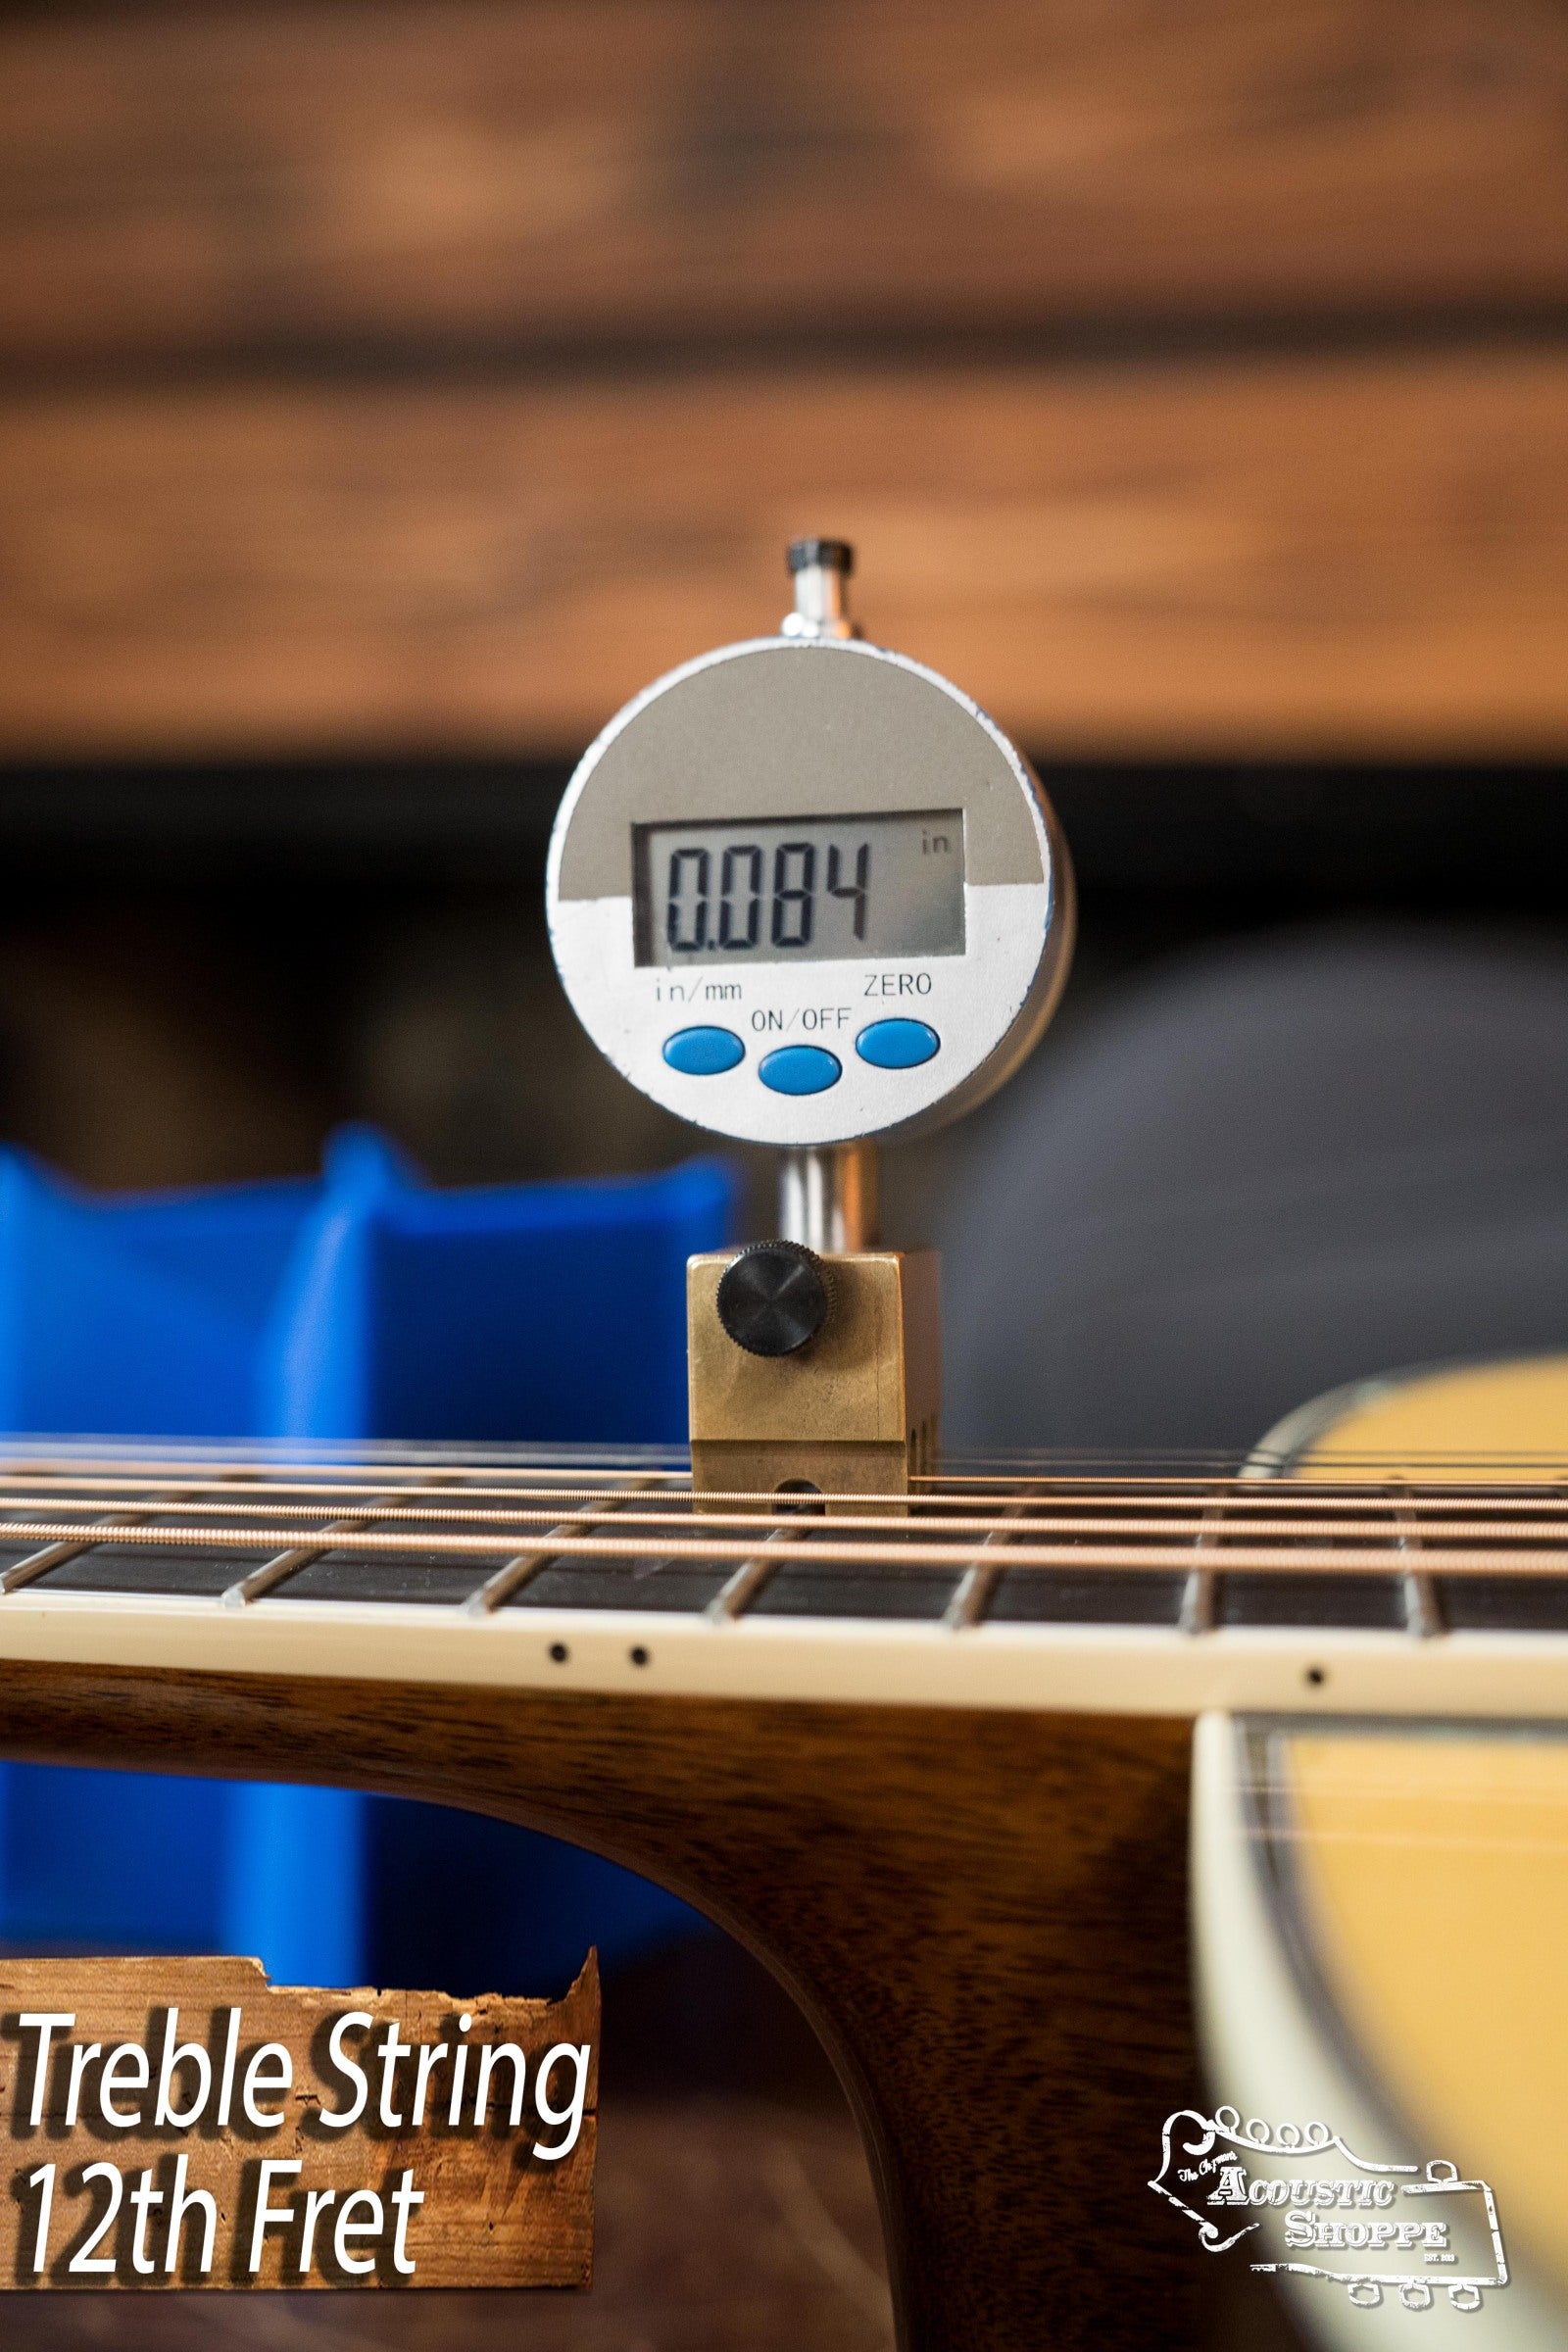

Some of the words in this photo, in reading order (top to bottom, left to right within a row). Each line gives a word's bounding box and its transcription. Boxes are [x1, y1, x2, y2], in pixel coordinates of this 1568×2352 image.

[921, 830, 950, 855] in
[666, 841, 869, 953] 0.084
[655, 977, 742, 1002] in/mm
[863, 973, 932, 997] ZERO
[751, 1007, 852, 1032] ON/OFF
